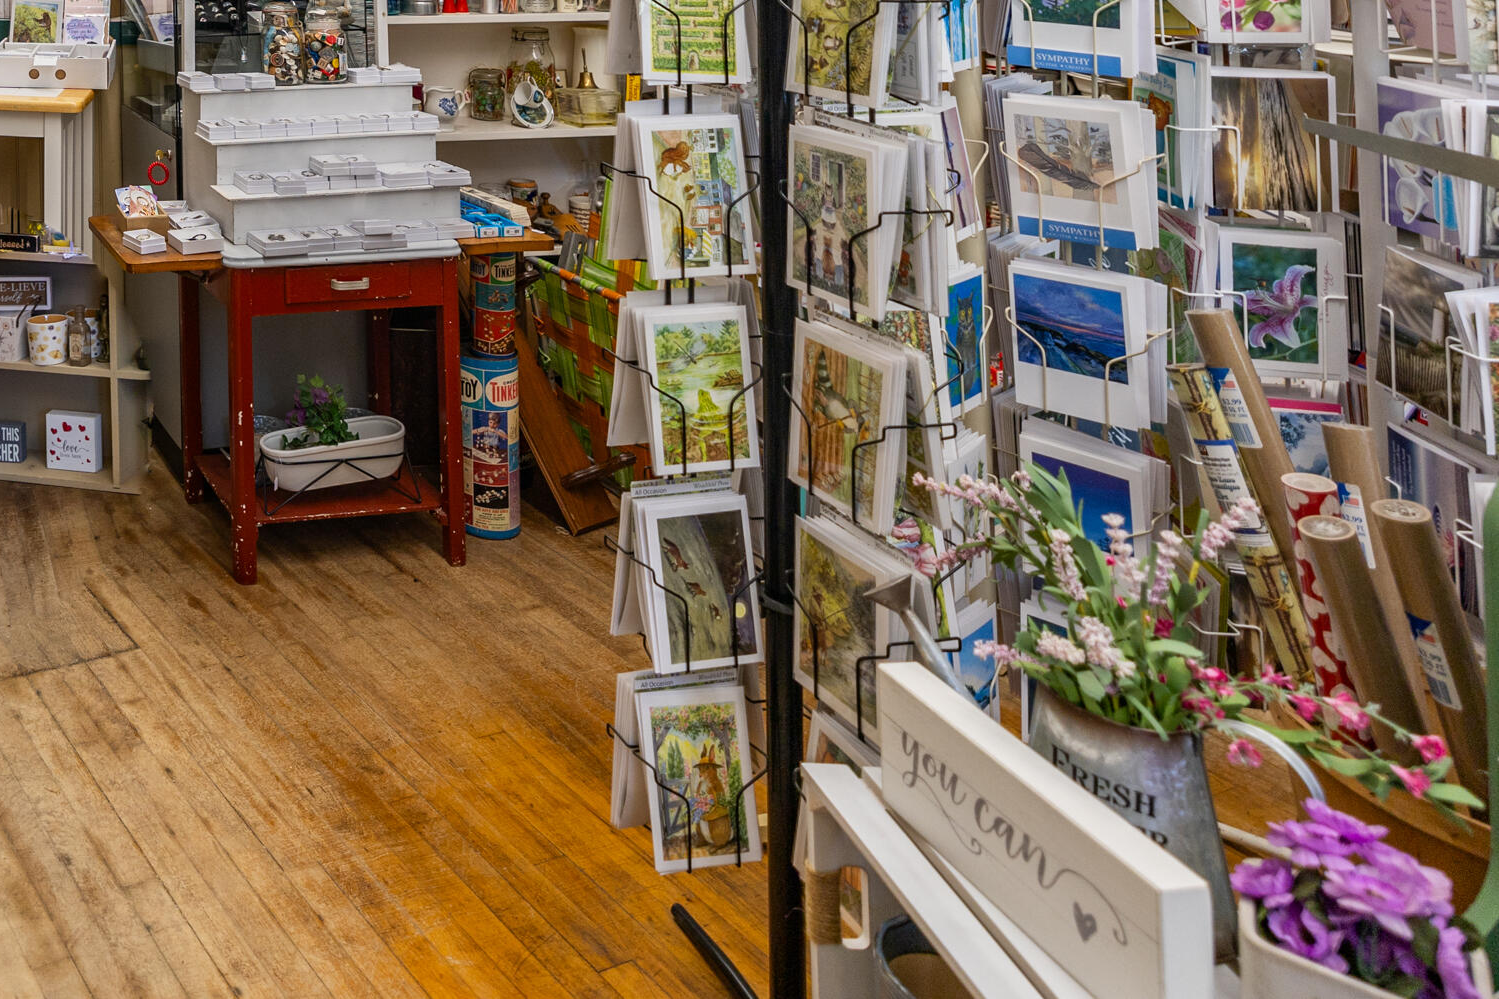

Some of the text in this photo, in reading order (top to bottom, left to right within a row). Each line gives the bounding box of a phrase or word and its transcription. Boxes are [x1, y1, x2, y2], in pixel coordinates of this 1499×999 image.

[1036, 52, 1090, 65] SYMPATHY
[816, 112, 831, 123] Spring
[1047, 224, 1103, 238] SYMPATHY
[1, 427, 20, 441] THIS
[643, 487, 668, 495] Occasion
[649, 679, 674, 688] Occasion
[1050, 744, 1159, 818] FRESH
[902, 726, 1059, 890] you can
